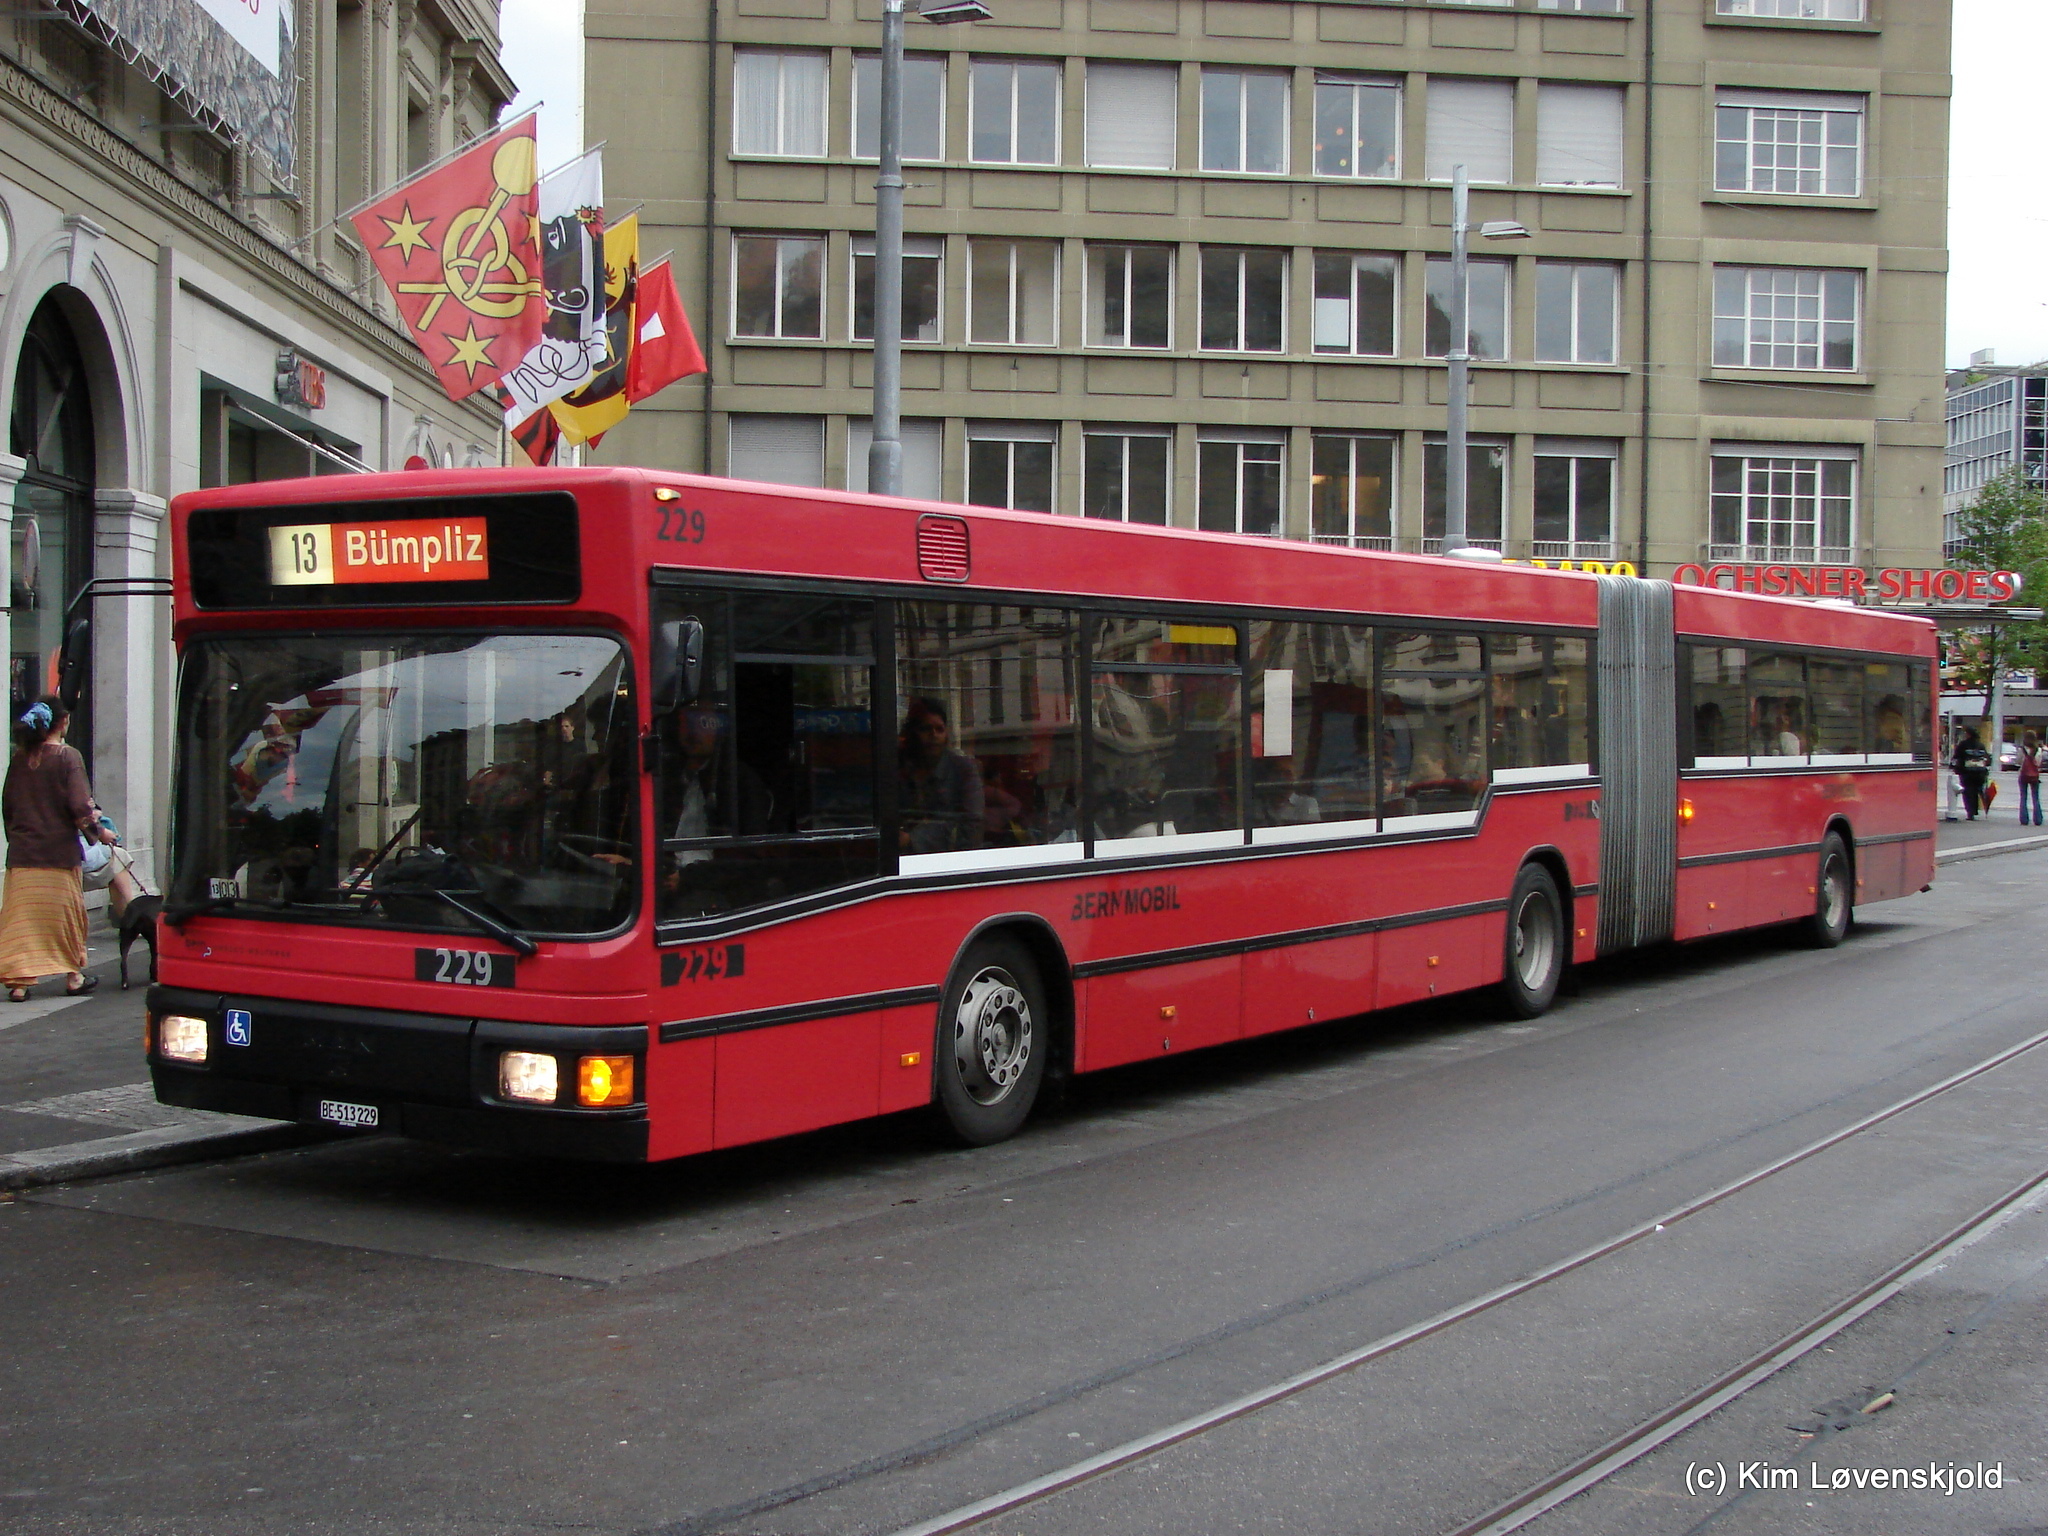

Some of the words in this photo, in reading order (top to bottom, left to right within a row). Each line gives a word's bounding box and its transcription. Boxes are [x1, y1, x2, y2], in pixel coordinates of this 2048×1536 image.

[656, 506, 705, 544] 229
[291, 532, 318, 574] 13
[346, 525, 484, 573] Bümpliz
[1673, 563, 1866, 597] OCHSNER
[1879, 568, 2013, 601] SHOES
[434, 948, 493, 985] 229
[678, 946, 729, 987] 229
